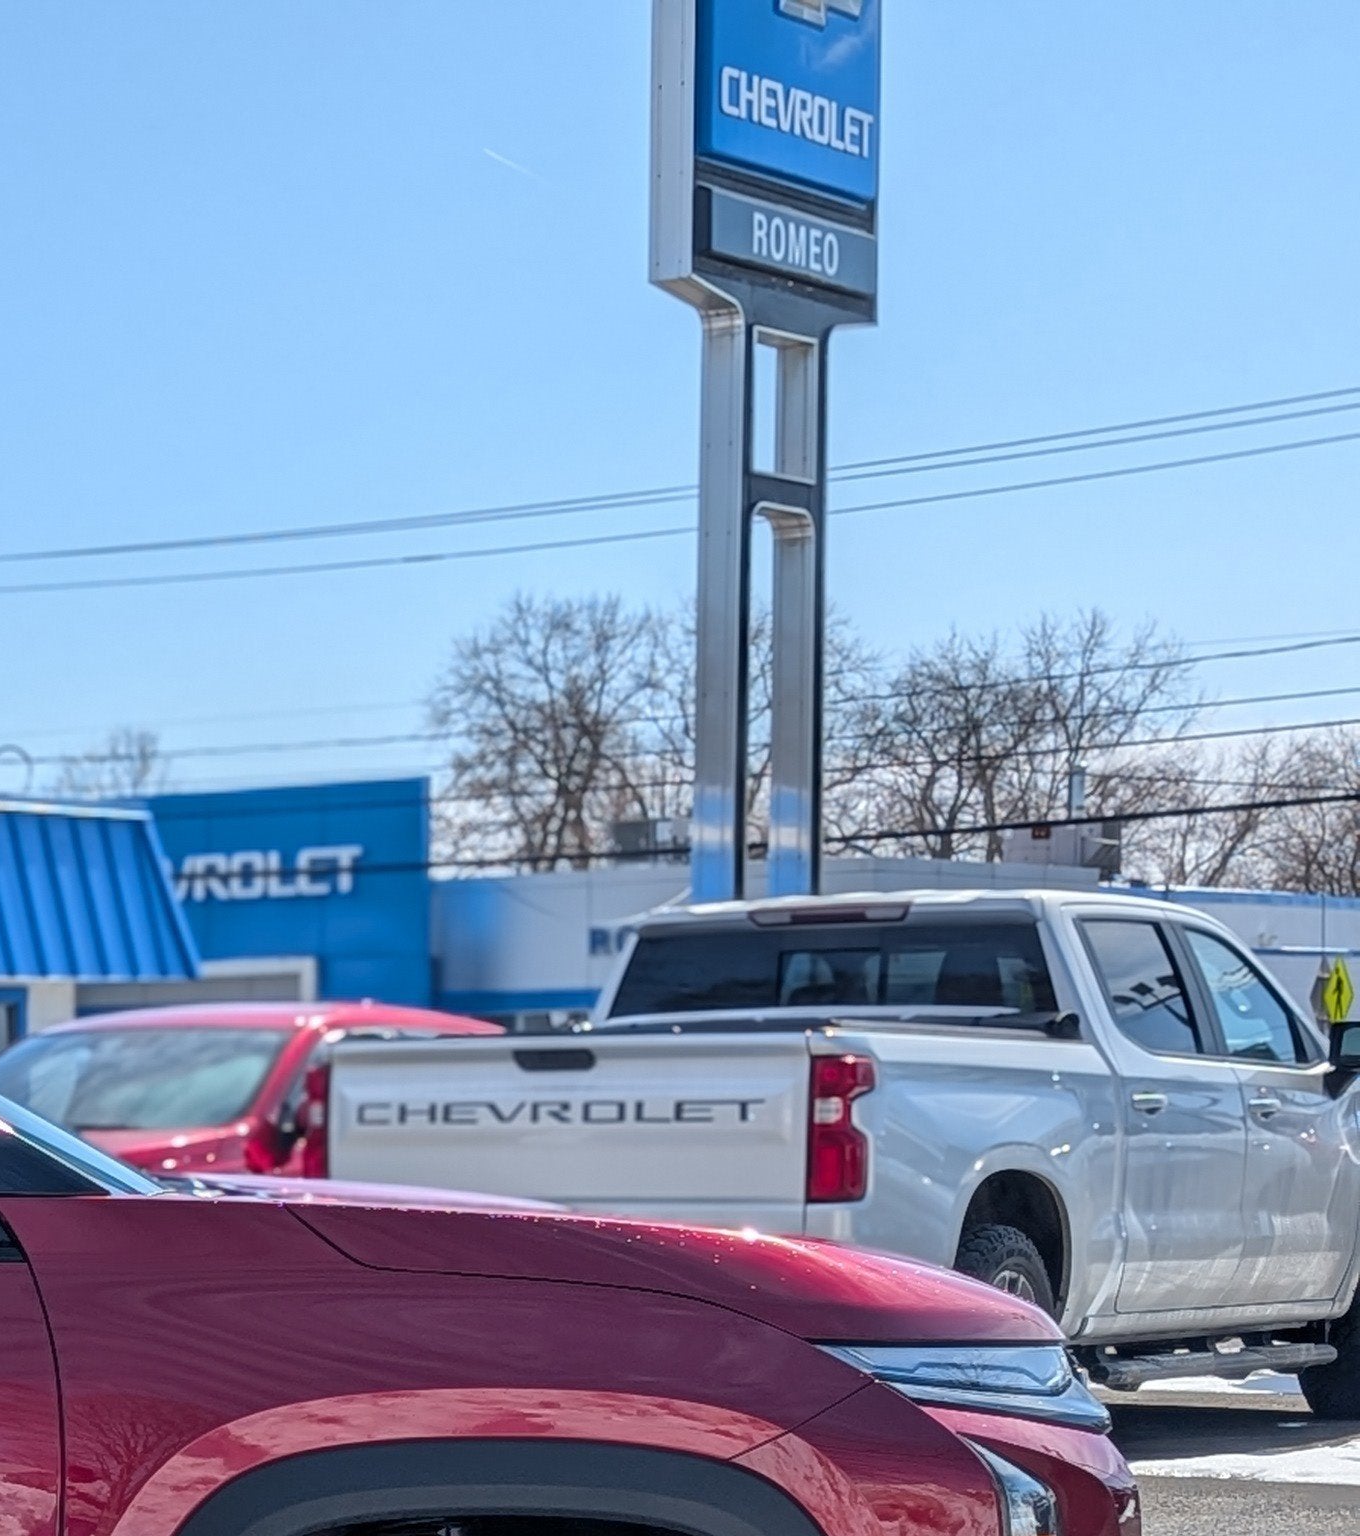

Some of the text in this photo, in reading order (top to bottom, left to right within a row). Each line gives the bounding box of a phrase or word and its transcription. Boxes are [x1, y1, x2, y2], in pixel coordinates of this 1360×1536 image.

[721, 66, 874, 158] CHEVROLET
[752, 211, 840, 276] ROMEO
[166, 844, 363, 902] VROLET
[356, 1098, 766, 1126] CHEVROLET
